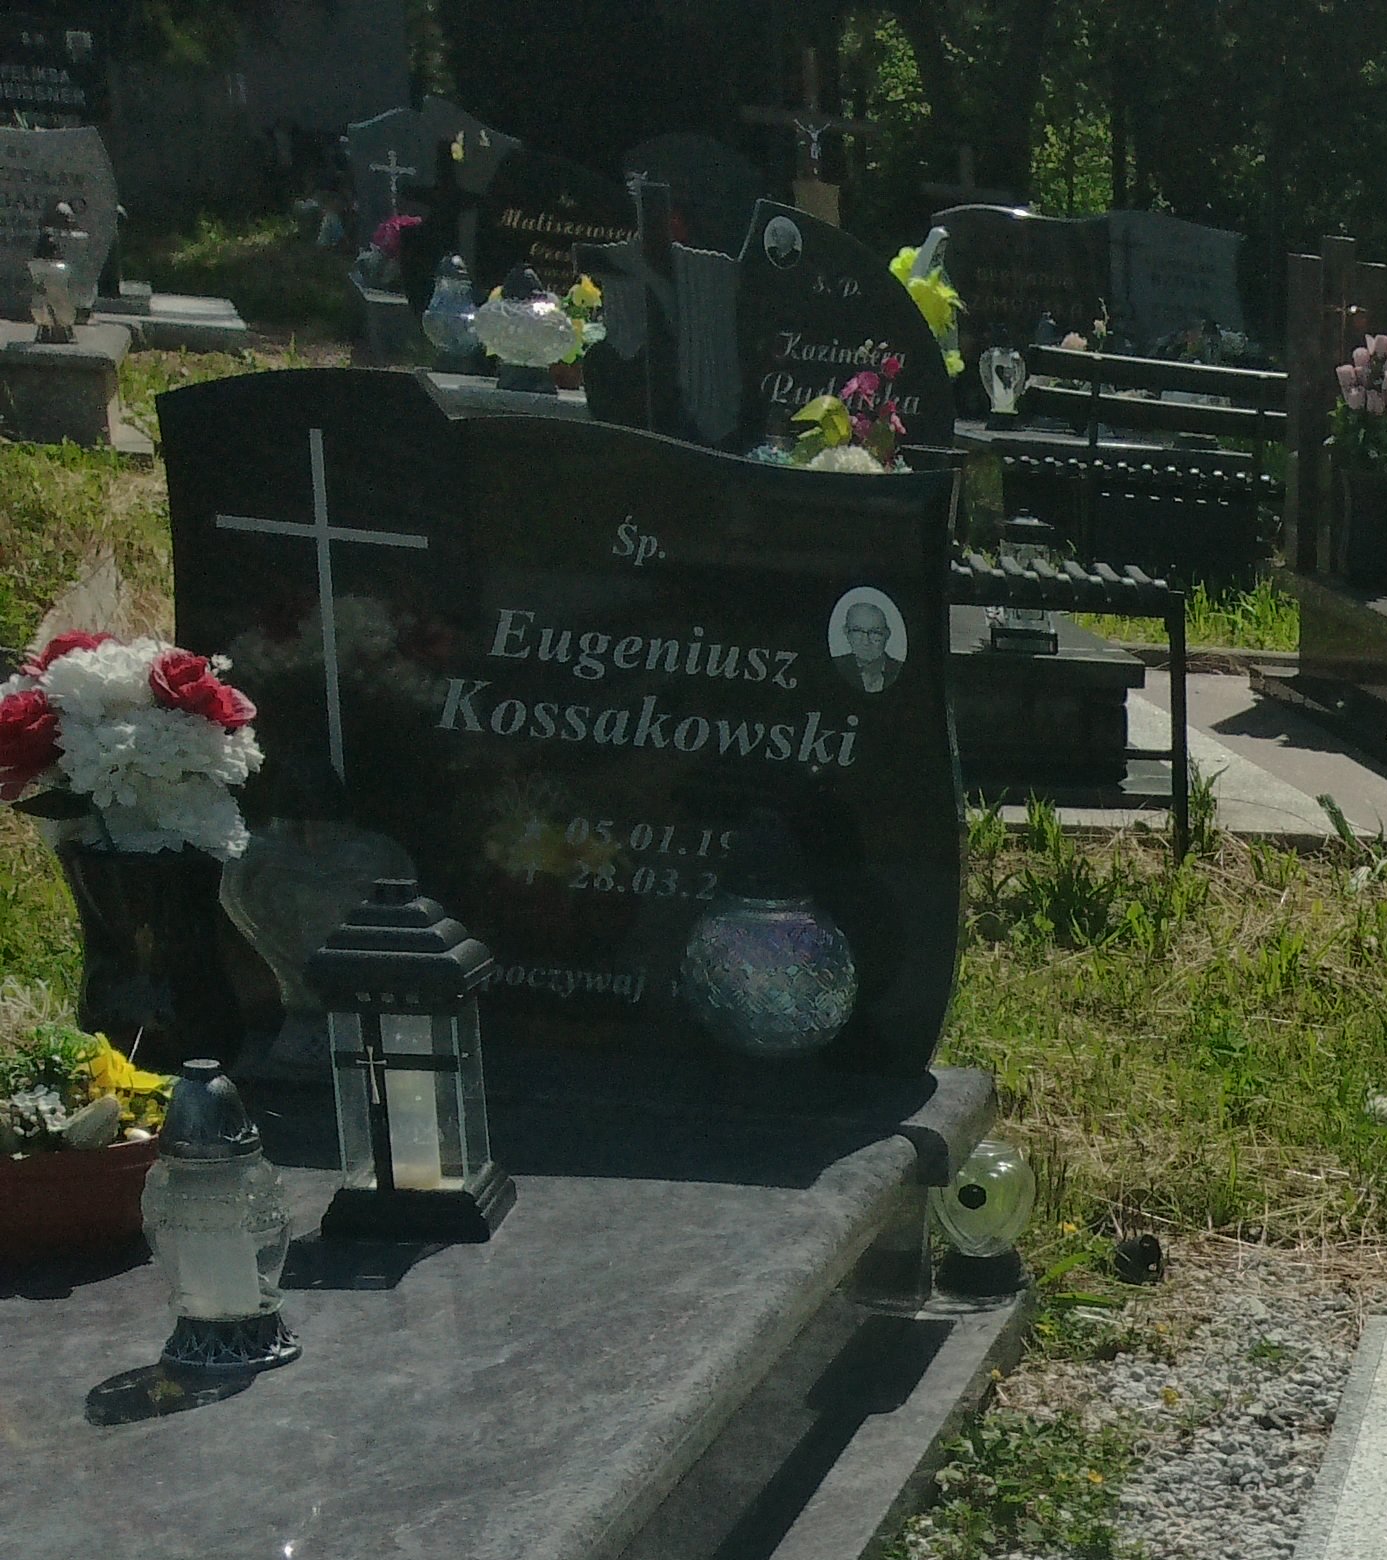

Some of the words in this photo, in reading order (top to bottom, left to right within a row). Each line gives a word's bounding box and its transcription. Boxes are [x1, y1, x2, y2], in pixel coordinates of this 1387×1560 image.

[612, 515, 666, 566] Śp.
[487, 608, 798, 689] Eugeniusz
[434, 677, 860, 767] Kossakowski
[564, 816, 738, 859] 05.01.19
[568, 860, 719, 901] 28.03.2
[480, 962, 647, 1004] poczywaj
